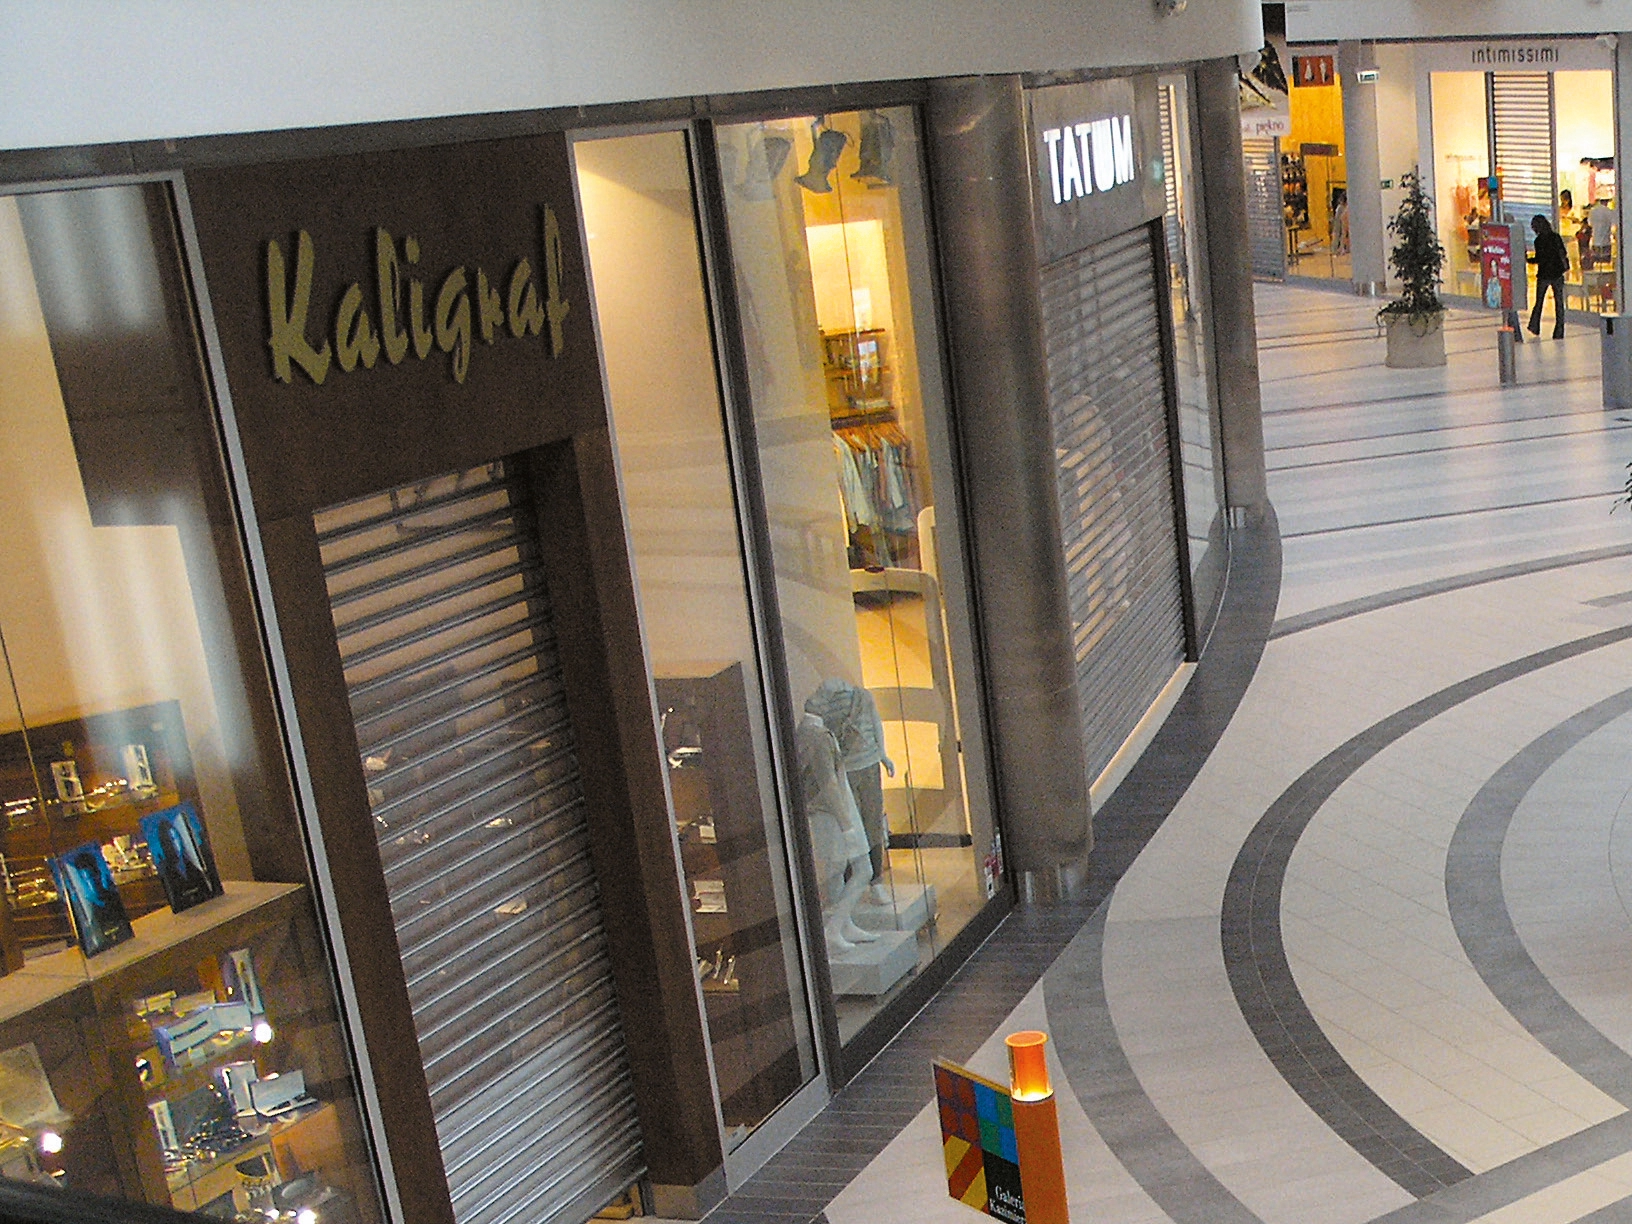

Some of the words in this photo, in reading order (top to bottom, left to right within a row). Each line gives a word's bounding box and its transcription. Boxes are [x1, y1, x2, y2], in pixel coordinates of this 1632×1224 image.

[1472, 46, 1559, 63] intimissimi
[1043, 115, 1135, 204] TATUM
[266, 203, 570, 385] Kaligraf
